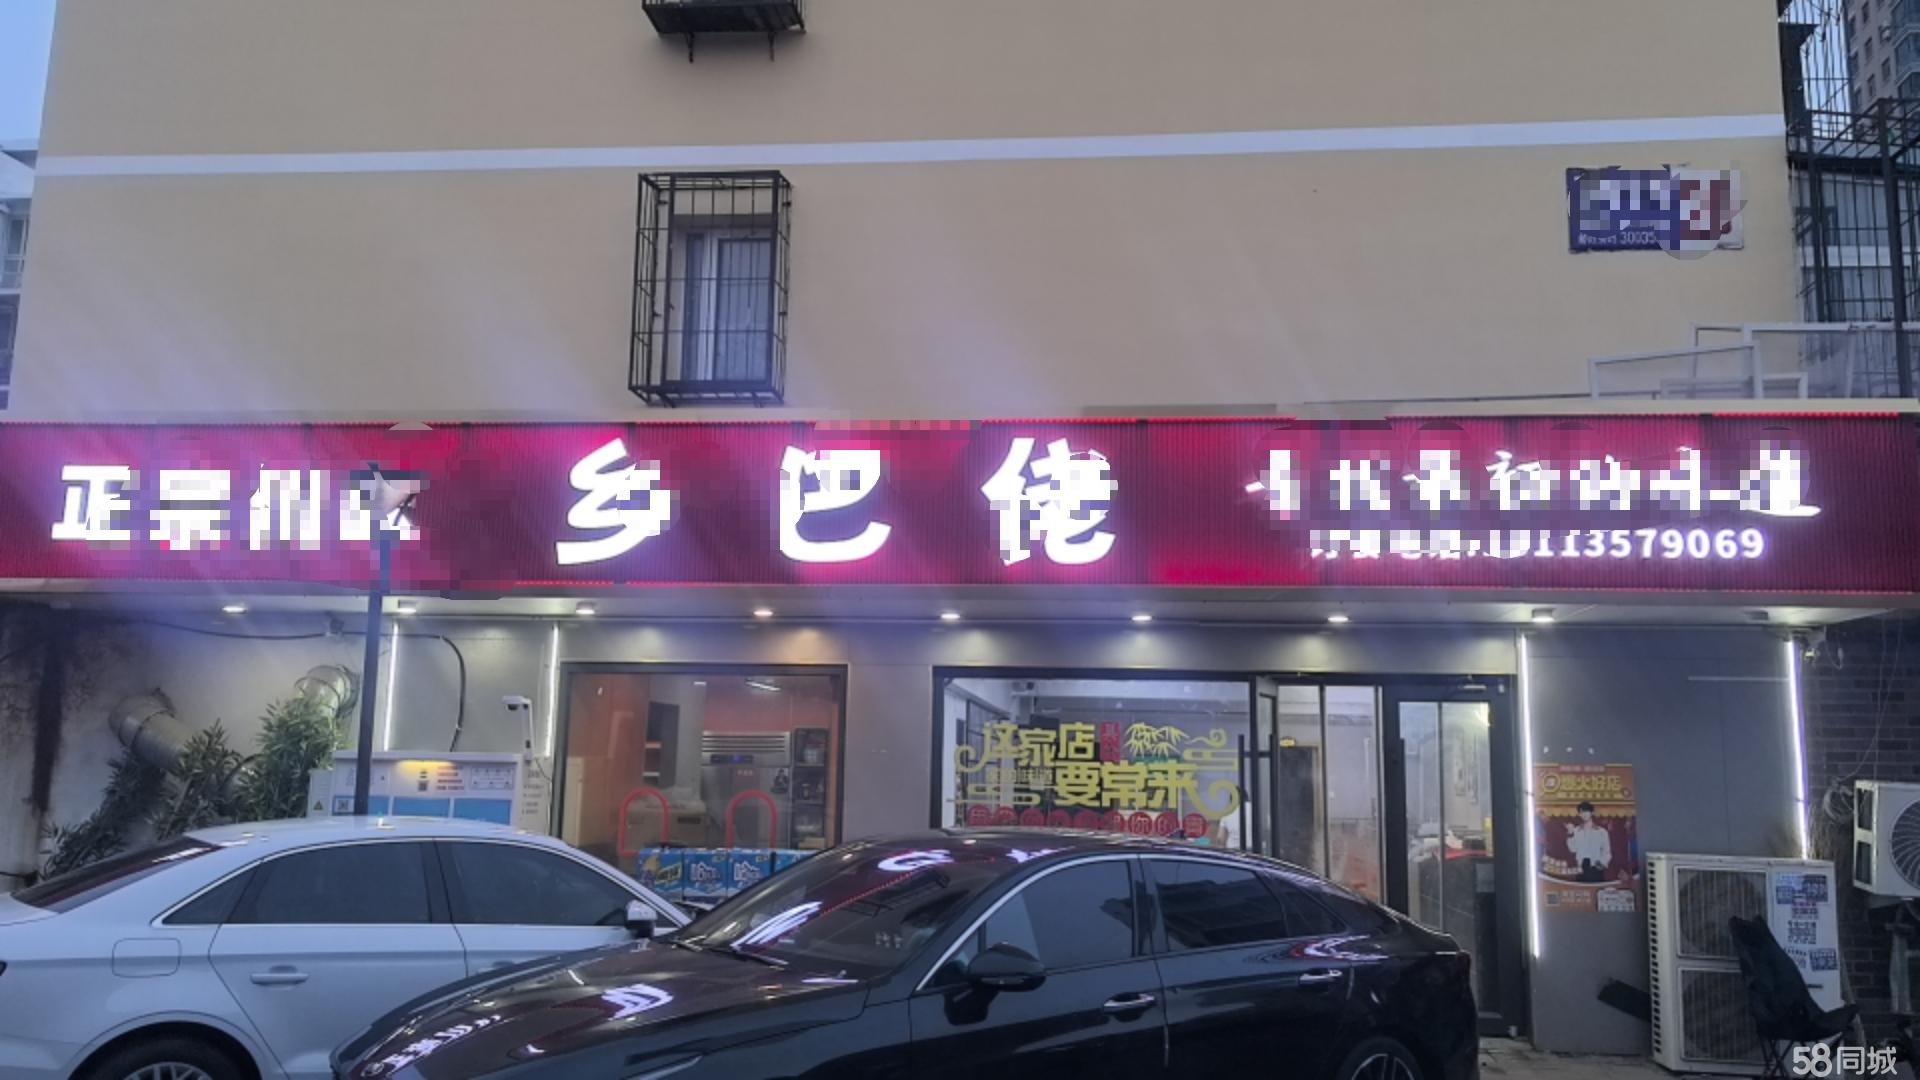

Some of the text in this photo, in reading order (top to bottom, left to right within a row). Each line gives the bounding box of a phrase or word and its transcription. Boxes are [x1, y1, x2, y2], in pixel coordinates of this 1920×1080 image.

[51, 464, 422, 551] 正宗川
[555, 437, 1118, 566] 乡巴佬
[954, 721, 1096, 773] 这家店
[1053, 760, 1198, 808] 要常来
